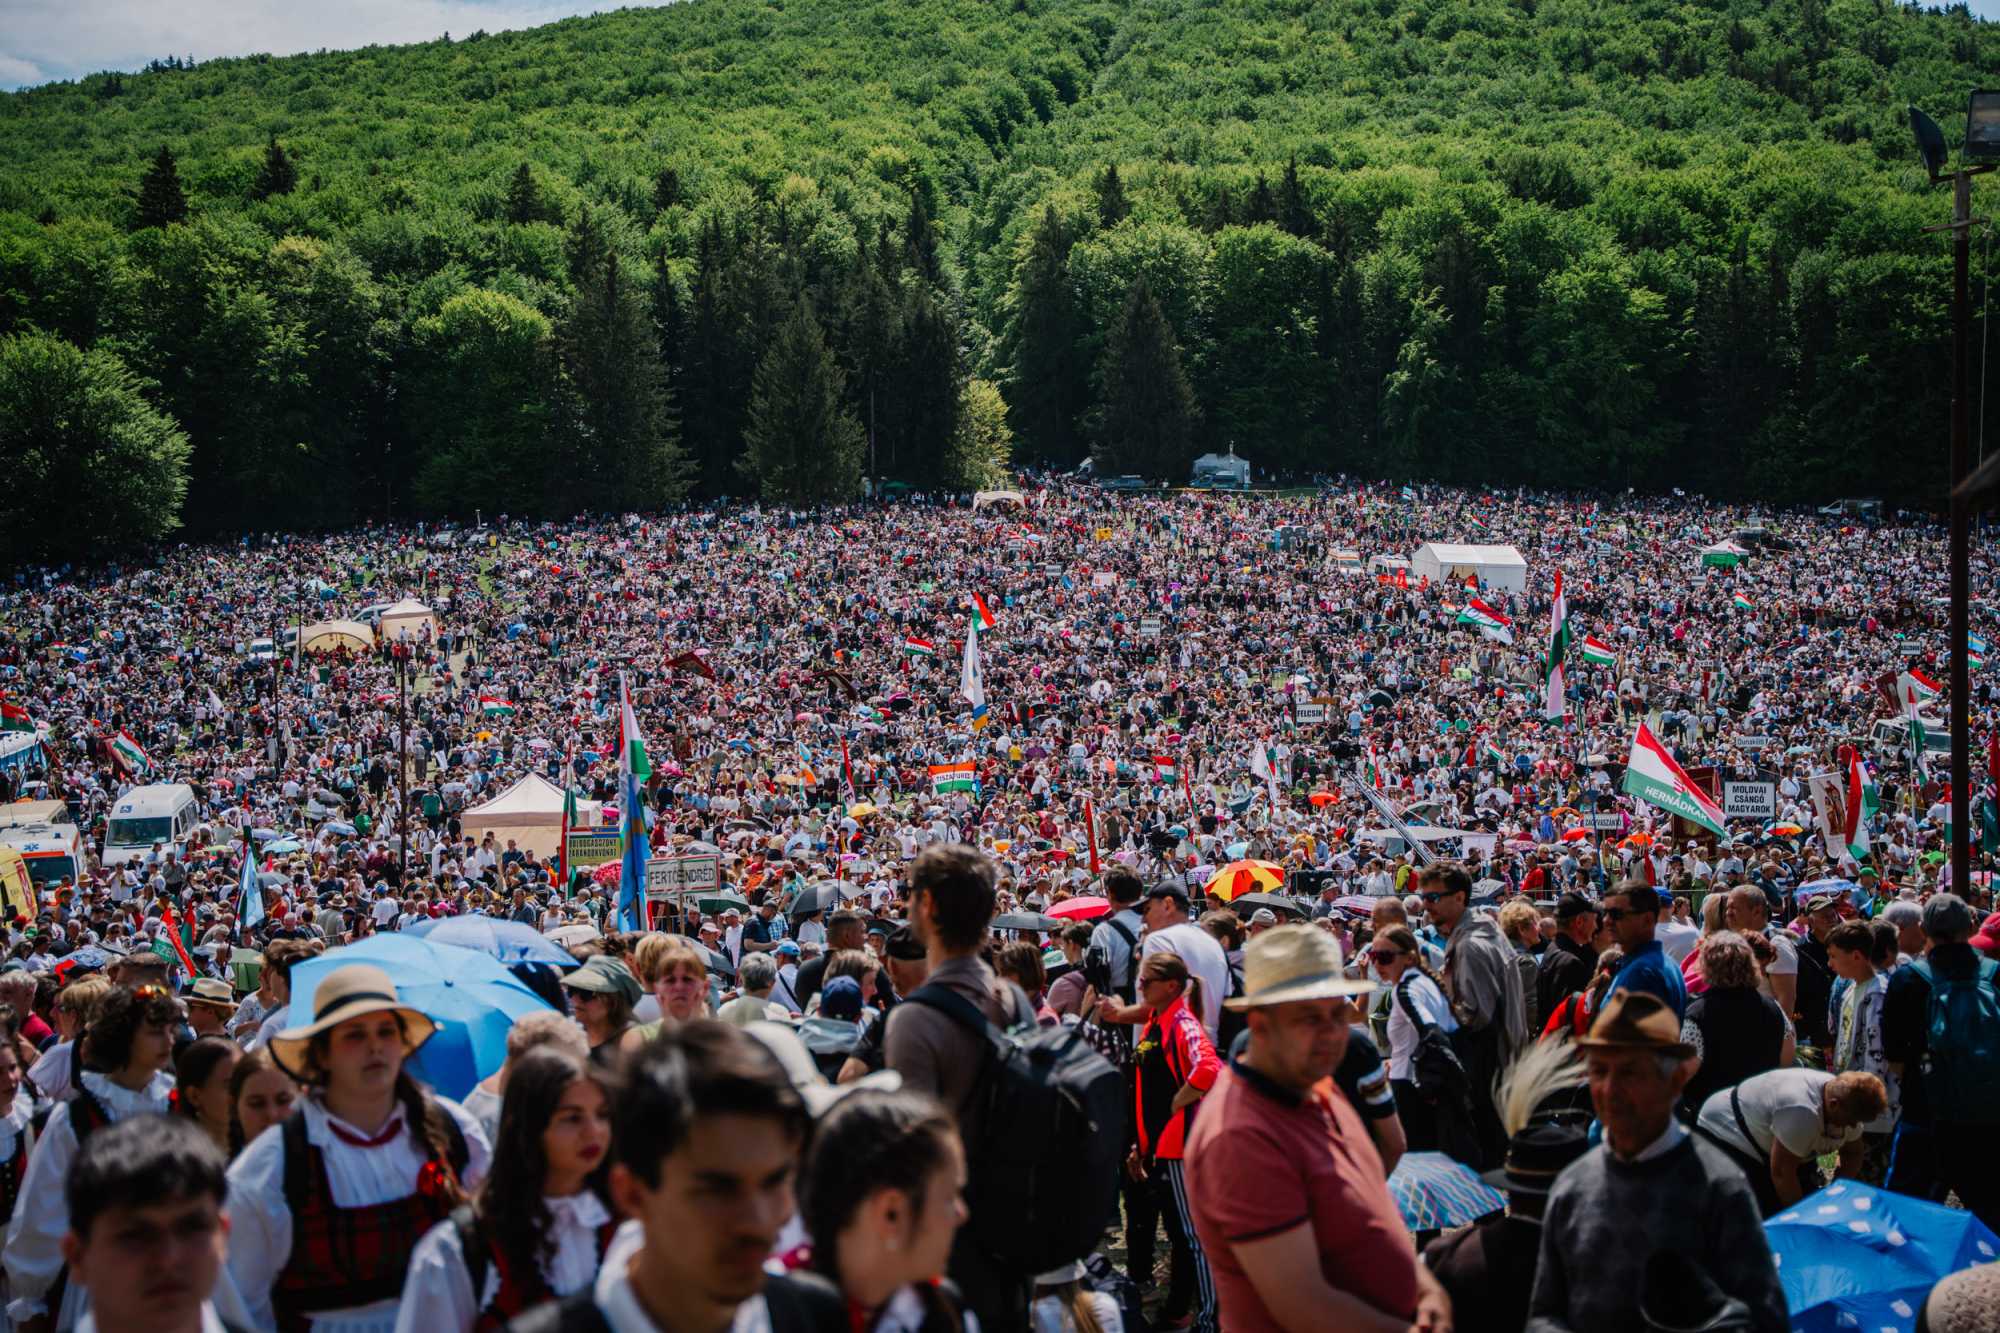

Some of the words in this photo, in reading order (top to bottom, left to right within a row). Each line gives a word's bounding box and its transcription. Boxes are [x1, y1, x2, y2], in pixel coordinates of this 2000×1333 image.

[1732, 785, 1767, 794] MOLDVAI
[1734, 794, 1765, 804] CSÁNGÓ
[1728, 804, 1771, 814] MAGYAROK
